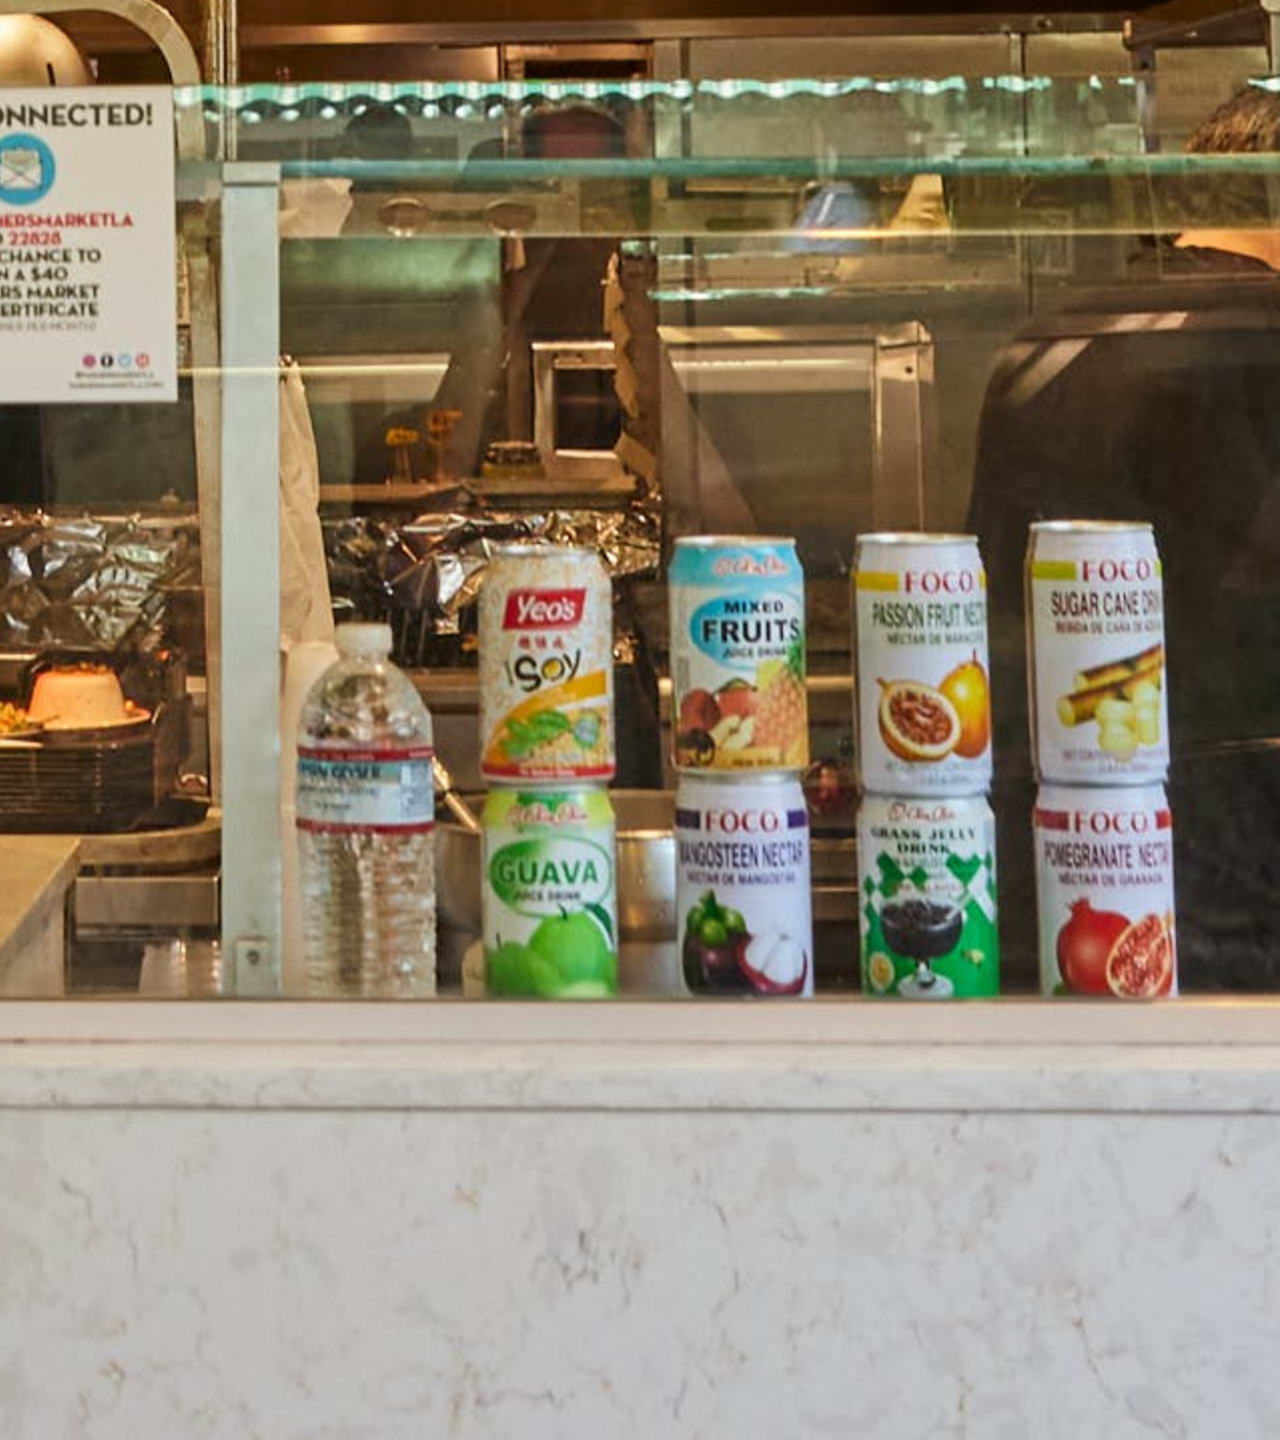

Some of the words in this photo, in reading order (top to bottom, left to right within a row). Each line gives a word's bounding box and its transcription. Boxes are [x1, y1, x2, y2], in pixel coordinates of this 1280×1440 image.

[8, 232, 62, 246] 22828
[77, 249, 102, 263] TO
[14, 268, 26, 281] A
[31, 266, 69, 282] $40
[26, 285, 100, 299] MARKET
[904, 571, 973, 593] FOCO
[1082, 559, 1150, 582] FOCO
[518, 594, 576, 624] Yeo's
[723, 599, 784, 614] MIXED
[873, 602, 924, 627] PASSION
[927, 602, 960, 627] FRUIT
[1051, 591, 1099, 616] SUGAR
[1103, 591, 1139, 615] CANE
[702, 618, 800, 644] FRUITS
[705, 810, 778, 833] FOCO
[1075, 811, 1148, 834] FOCO
[498, 858, 598, 886] GUAVA
